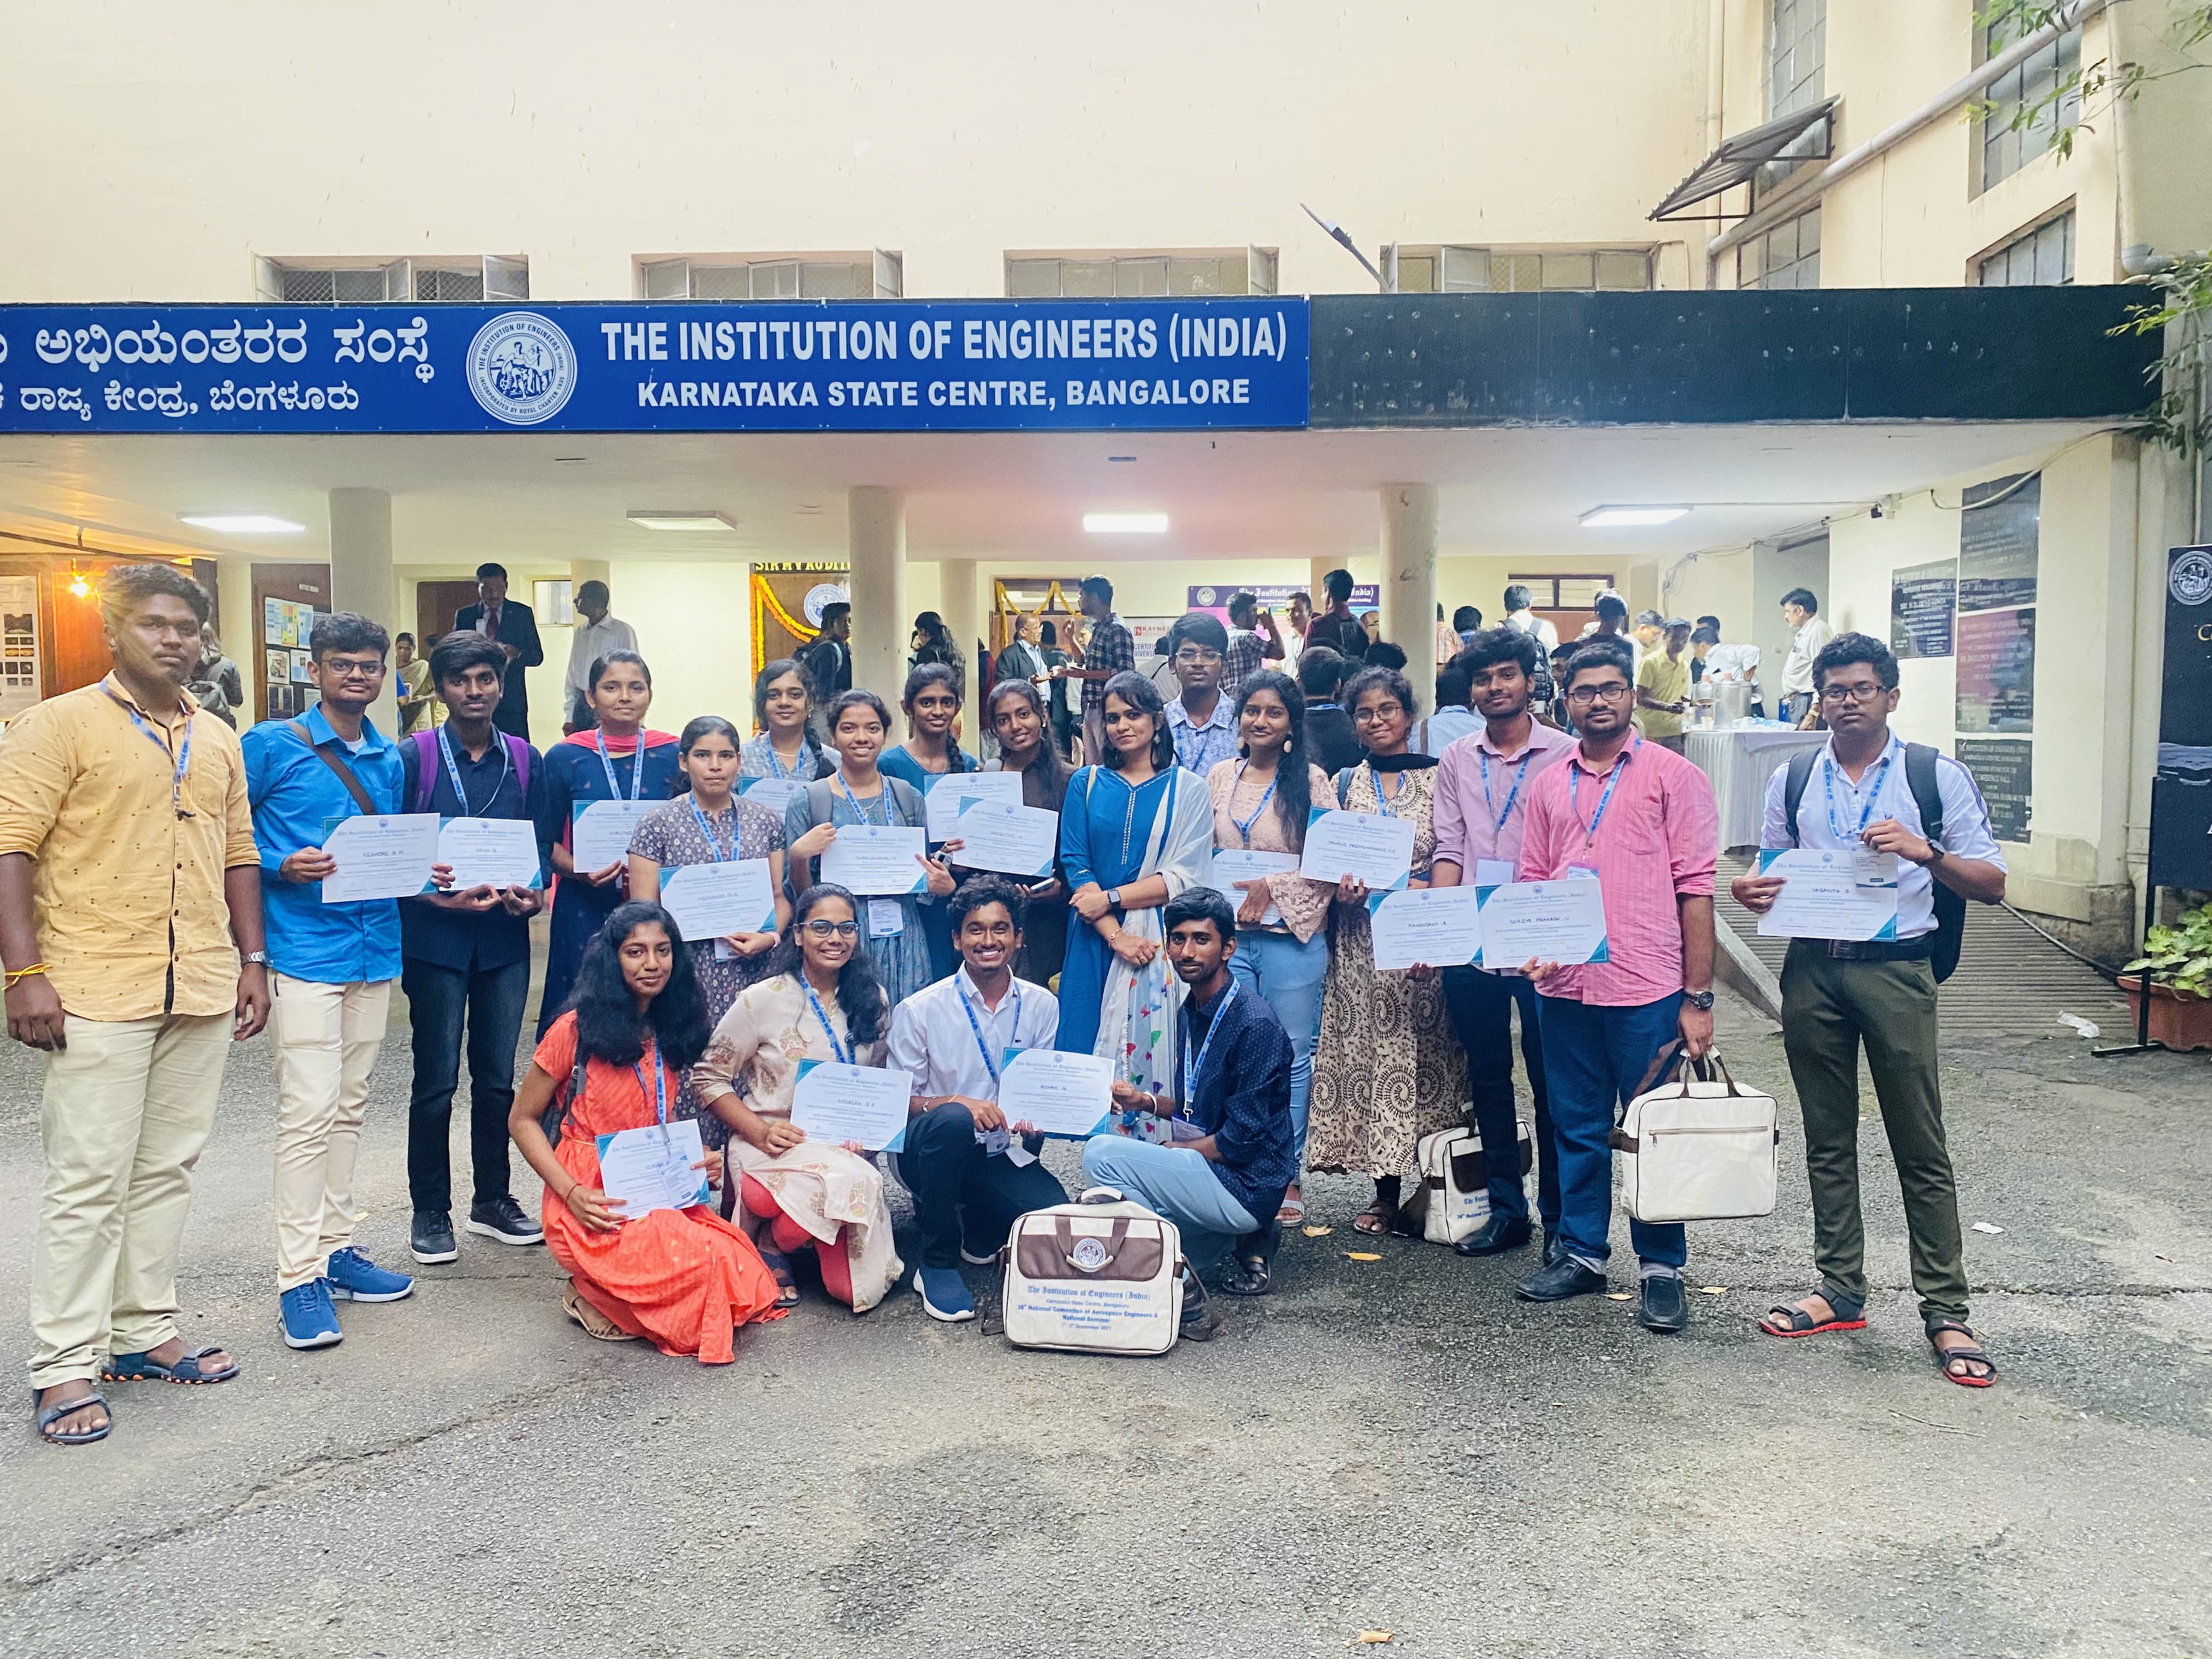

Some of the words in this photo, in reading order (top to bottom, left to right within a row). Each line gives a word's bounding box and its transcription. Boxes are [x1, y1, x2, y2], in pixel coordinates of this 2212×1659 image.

[35, 318, 307, 373] ಅಭಿಯಂತರರ
[333, 316, 435, 383] ಸಂಸ್ಥೆ
[481, 324, 514, 357] INSTITUTION
[528, 324, 560, 351] ENGINEERS
[556, 352, 564, 371] (INDIA)
[601, 322, 668, 360] THE
[680, 321, 896, 360] INSTITUTION
[909, 320, 951, 359] OF
[964, 319, 1157, 359] ENGINEERS
[1169, 312, 1286, 363] (INDIA)
[20, 386, 92, 421] ರಾಜ್ಯ
[104, 380, 199, 417] ಕೇಂದ್ರ,
[209, 379, 359, 411] ಬೆಂಗಳೂರು
[479, 377, 509, 410] INCORPORATED
[538, 391, 558, 410] CHARTER
[556, 377, 565, 390] 1935
[638, 382, 819, 407] KARNATAKA
[828, 381, 918, 406] STATE
[928, 381, 1056, 411] CENTRE,
[1066, 379, 1250, 405] BANGALORE
[755, 562, 779, 571] SIR
[1028, 1285, 1040, 1294] The
[1042, 1286, 1078, 1296] Institution
[1088, 1290, 1124, 1299] Engineers
[1125, 1291, 1150, 1301] (India)
